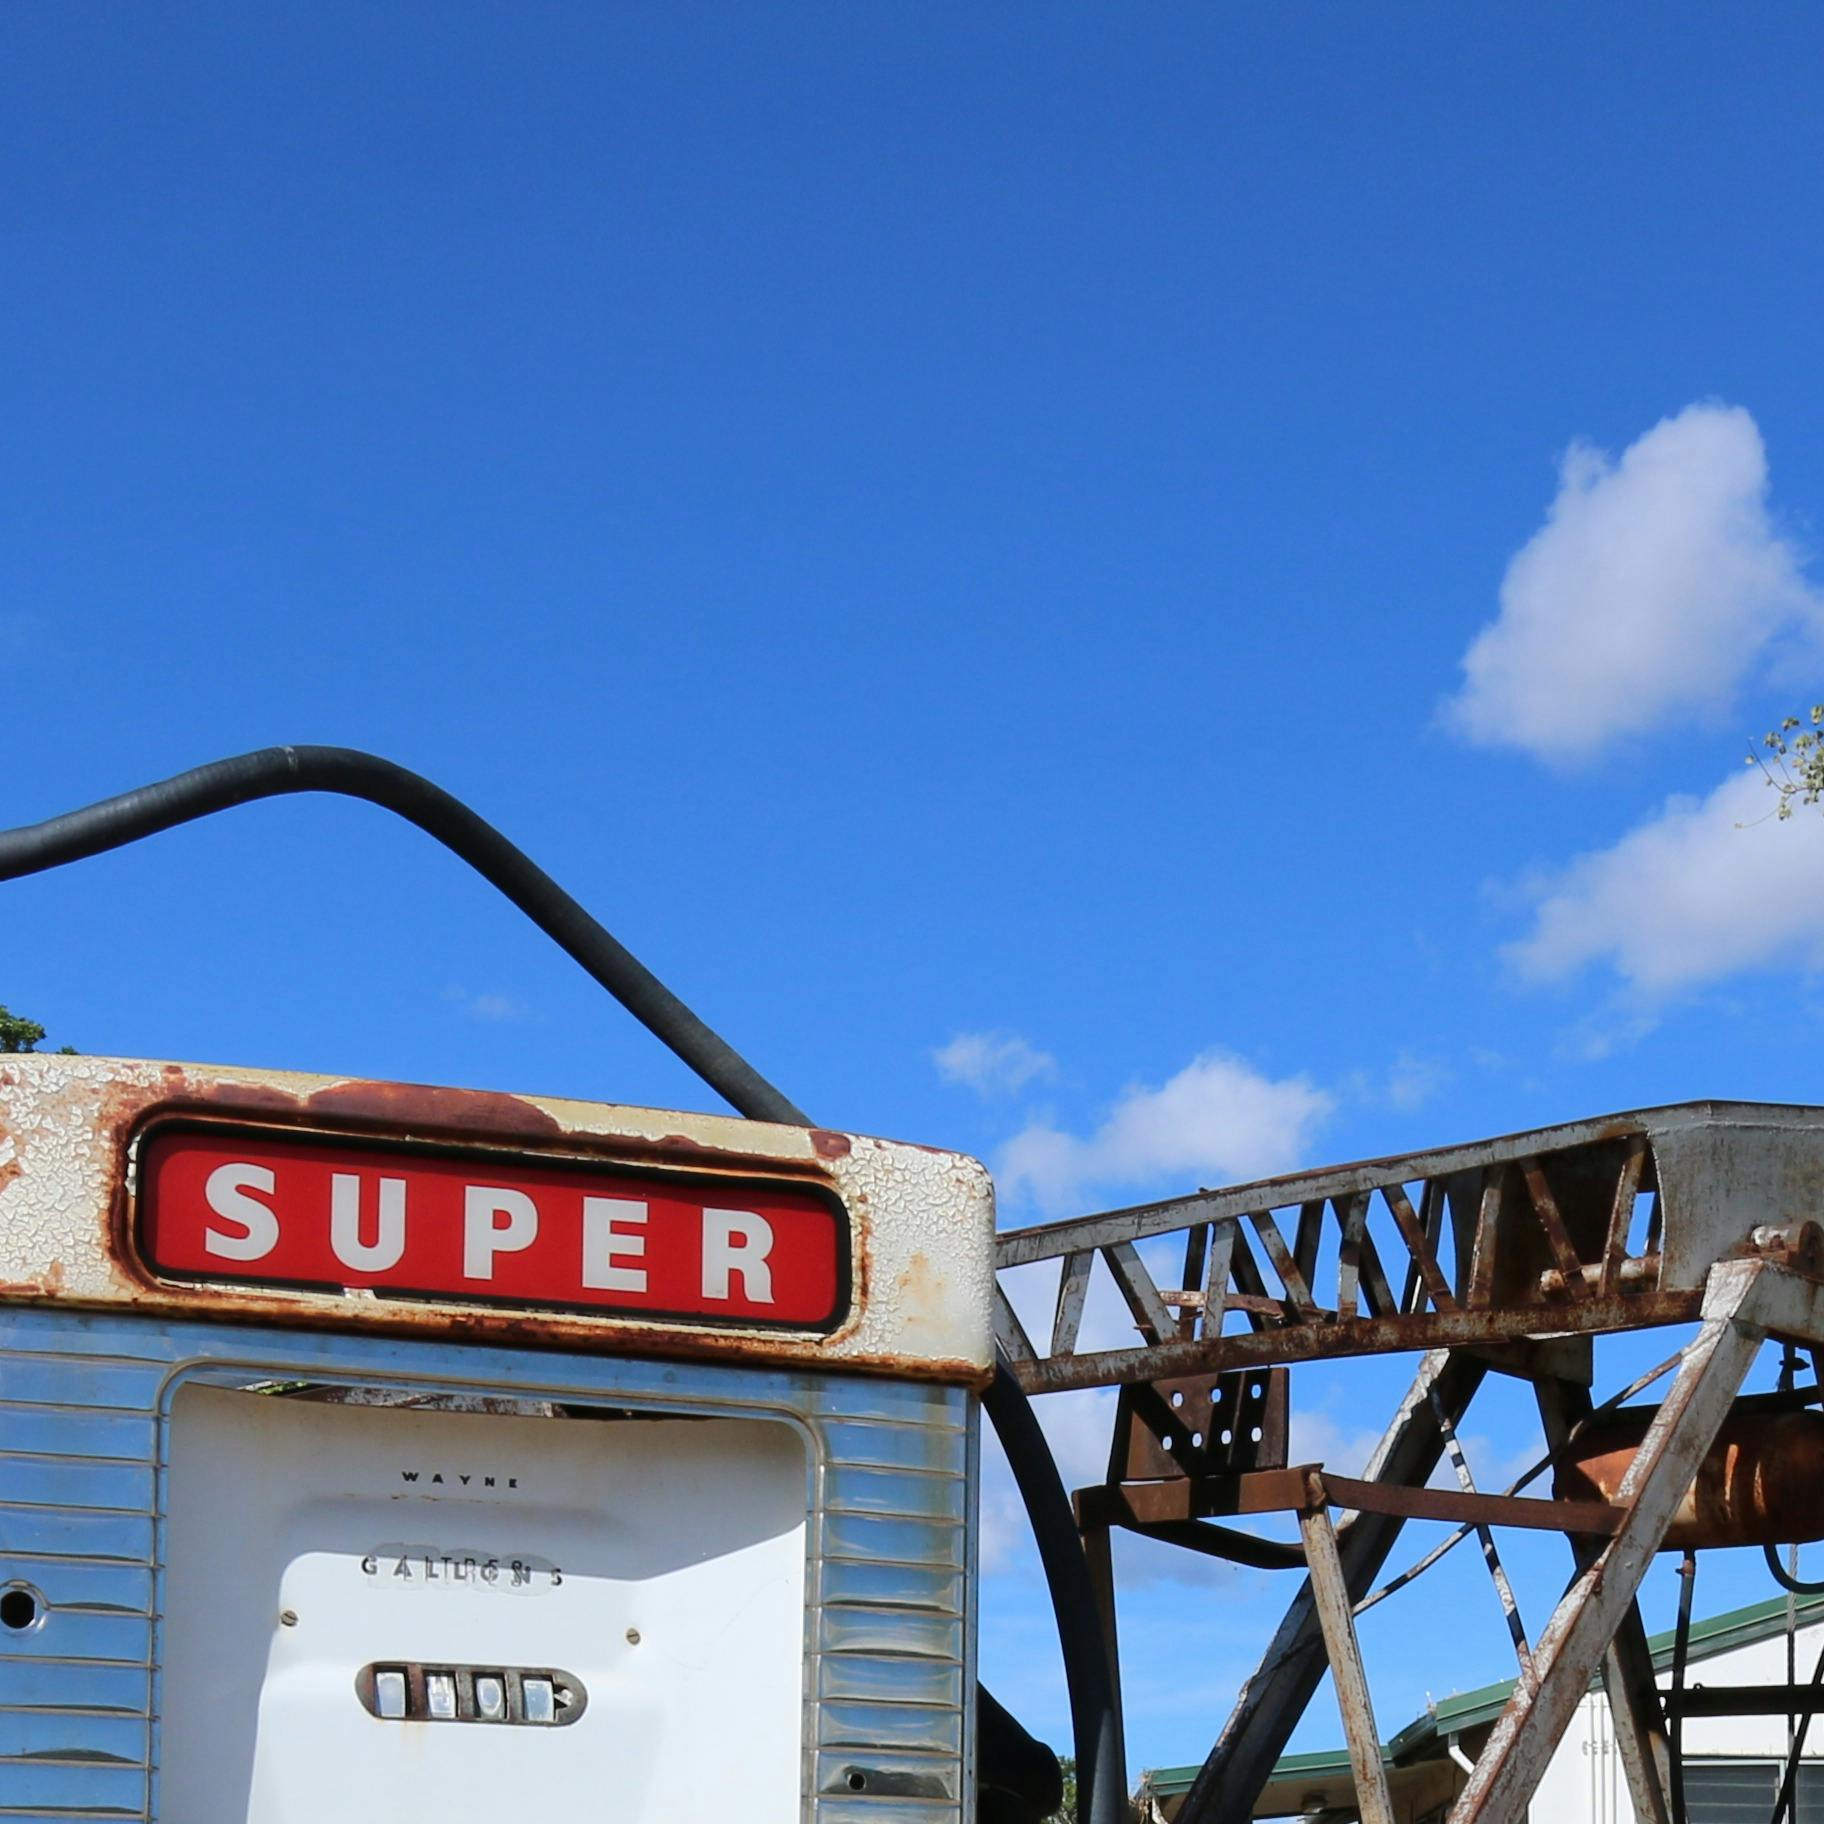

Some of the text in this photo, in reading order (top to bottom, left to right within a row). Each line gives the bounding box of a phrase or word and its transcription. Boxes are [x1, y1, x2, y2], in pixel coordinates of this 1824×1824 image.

[203, 1161, 777, 1306] SUPER
[401, 1471, 518, 1488] WAYNE
[361, 1555, 563, 1587] GALLONS
